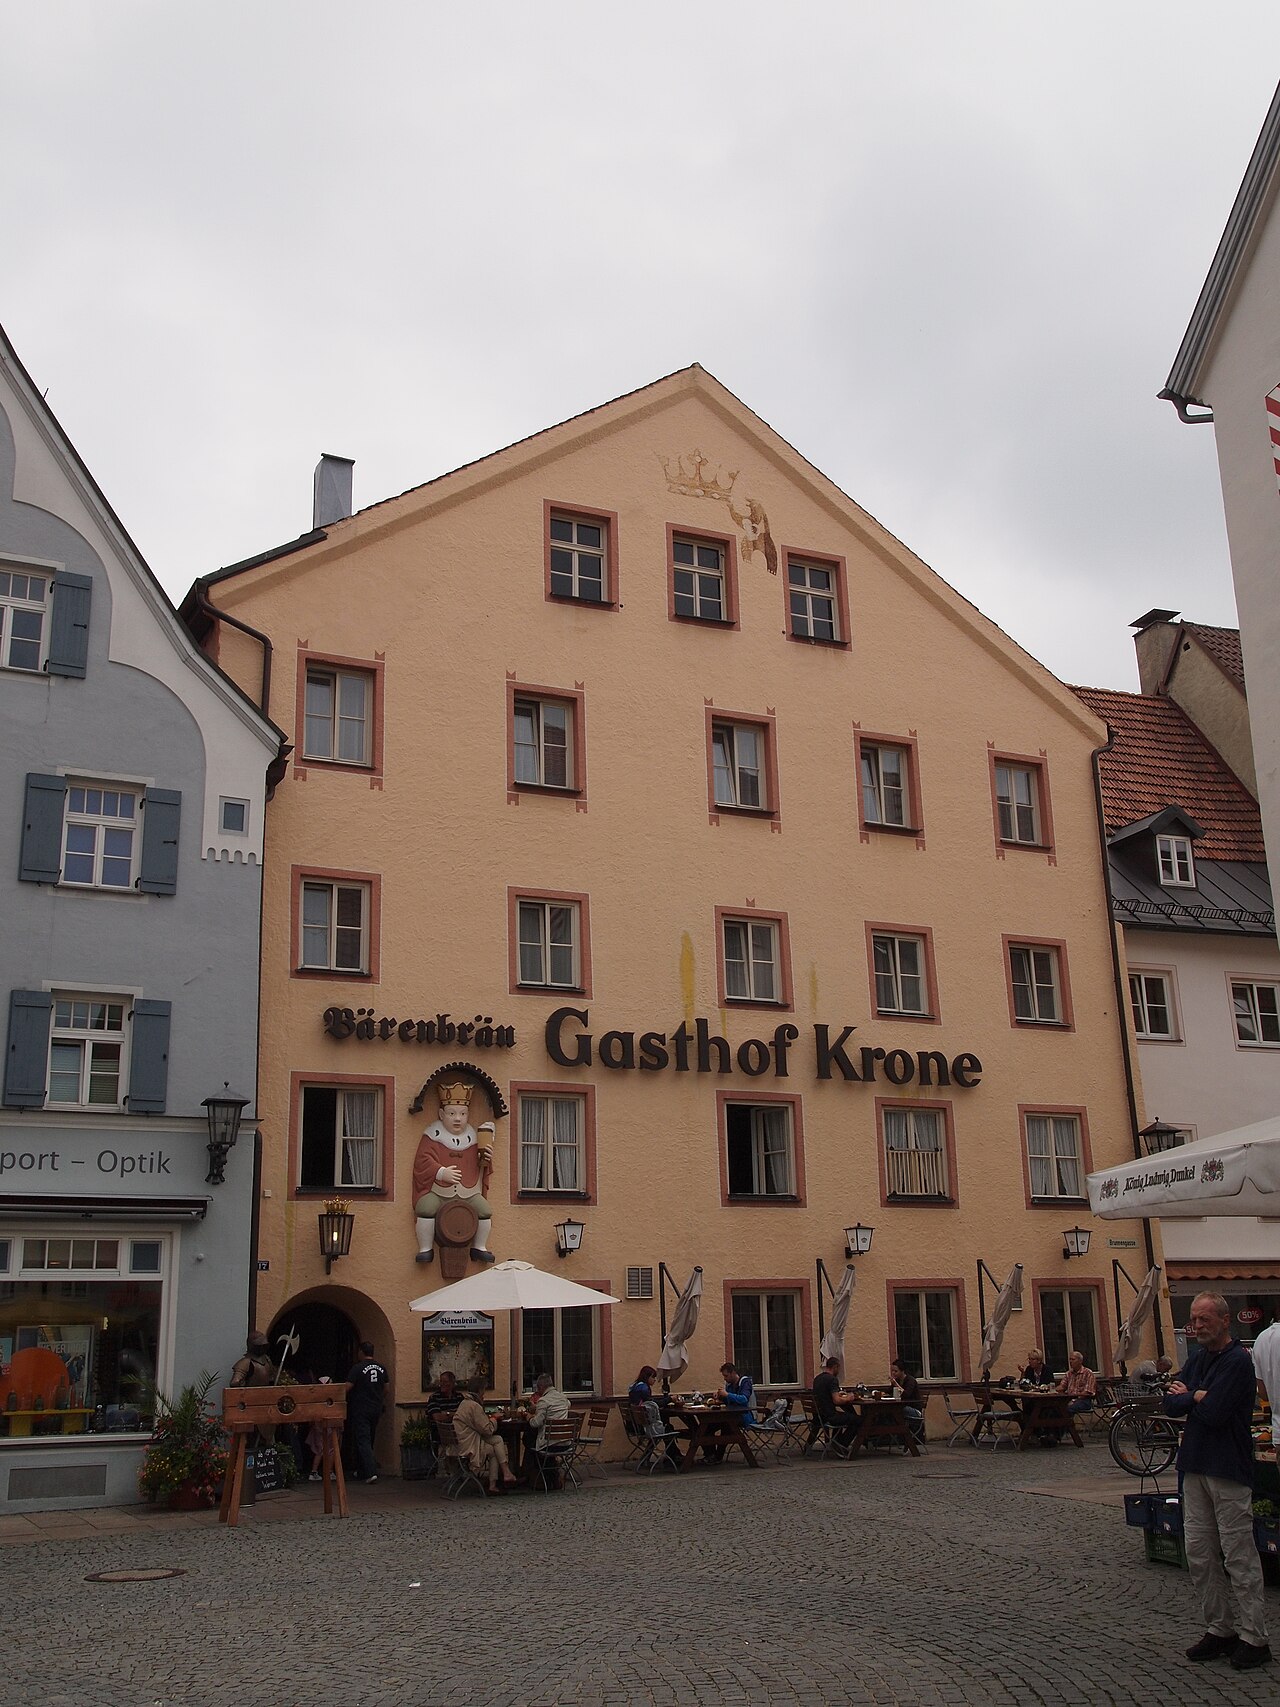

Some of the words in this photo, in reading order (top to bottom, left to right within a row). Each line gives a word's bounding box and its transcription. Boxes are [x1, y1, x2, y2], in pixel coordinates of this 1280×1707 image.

[323, 1006, 517, 1048] Bärenbräu
[545, 1006, 799, 1077] Gasthof
[813, 1023, 983, 1088] Krone
[97, 1150, 171, 1178] Optik
[1123, 1175, 1145, 1195] König
[1170, 1165, 1196, 1183] Dunkel
[440, 1316, 478, 1325] Bärenbräu
[1241, 1310, 1260, 1319] 50%
[370, 1369, 378, 1383] 2
